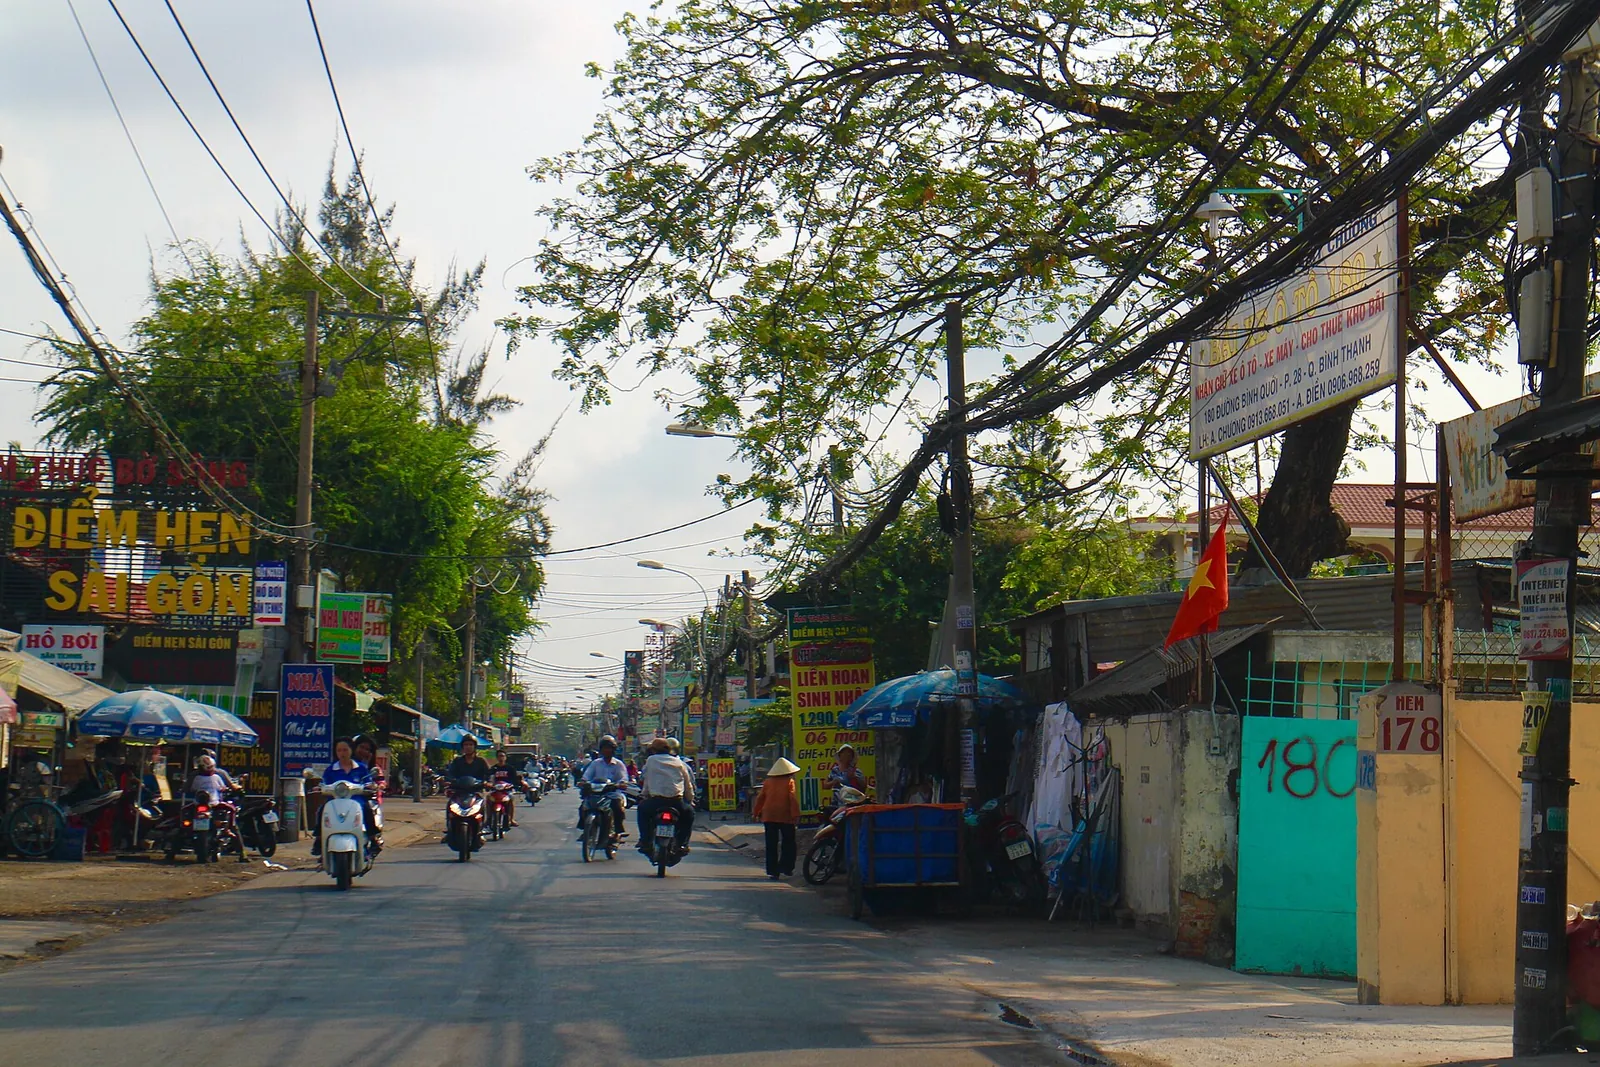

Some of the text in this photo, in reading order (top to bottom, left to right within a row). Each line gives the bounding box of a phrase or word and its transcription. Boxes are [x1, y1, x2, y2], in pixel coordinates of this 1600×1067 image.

[1274, 288, 1287, 334] Ô
[1292, 269, 1318, 324] TÔ
[1327, 251, 1366, 305] 180
[1229, 367, 1238, 386] XE
[1240, 361, 1245, 380] Ô
[1247, 354, 1257, 377] TÔ
[1264, 350, 1274, 368] XE
[1276, 337, 1294, 363] MÁY
[1301, 326, 1318, 350] CHO
[1320, 311, 1343, 340] THUÊ
[1346, 304, 1366, 329] KHO
[1368, 289, 1385, 317] BÃI
[1204, 408, 1214, 425] 180
[1216, 397, 1240, 418] ĐƯỜNG
[1242, 388, 1258, 409] BÌNH
[1284, 373, 1291, 389] P.
[1293, 368, 1302, 385] 28
[1308, 361, 1316, 377] Q.
[1320, 350, 1339, 373] BÌNH
[1341, 334, 1371, 362] THẠNH
[1210, 431, 1217, 444] A.
[1218, 417, 1246, 441] CHƯƠNG
[1296, 393, 1304, 409] A.
[1327, 358, 1380, 396] 0906.968.259
[12, 486, 252, 564] ĐIỂM HẸN
[44, 560, 250, 616] SÀI GÒN
[1521, 578, 1566, 591] INTERNET
[1548, 590, 1565, 603] PHÍ
[25, 626, 99, 649] HỒ BƠI
[132, 632, 162, 648] ĐIỂM
[163, 636, 186, 651] HẸN
[187, 635, 207, 649] SÀI
[208, 635, 232, 650] GÒN
[287, 668, 326, 692] NHÀ
[797, 667, 870, 687] LIÊN HOAN
[284, 691, 331, 717] NGHỈ
[797, 691, 831, 708] SINH
[798, 710, 844, 728] 1.290.
[1381, 716, 1440, 752] 178
[710, 778, 735, 800] TẤM
